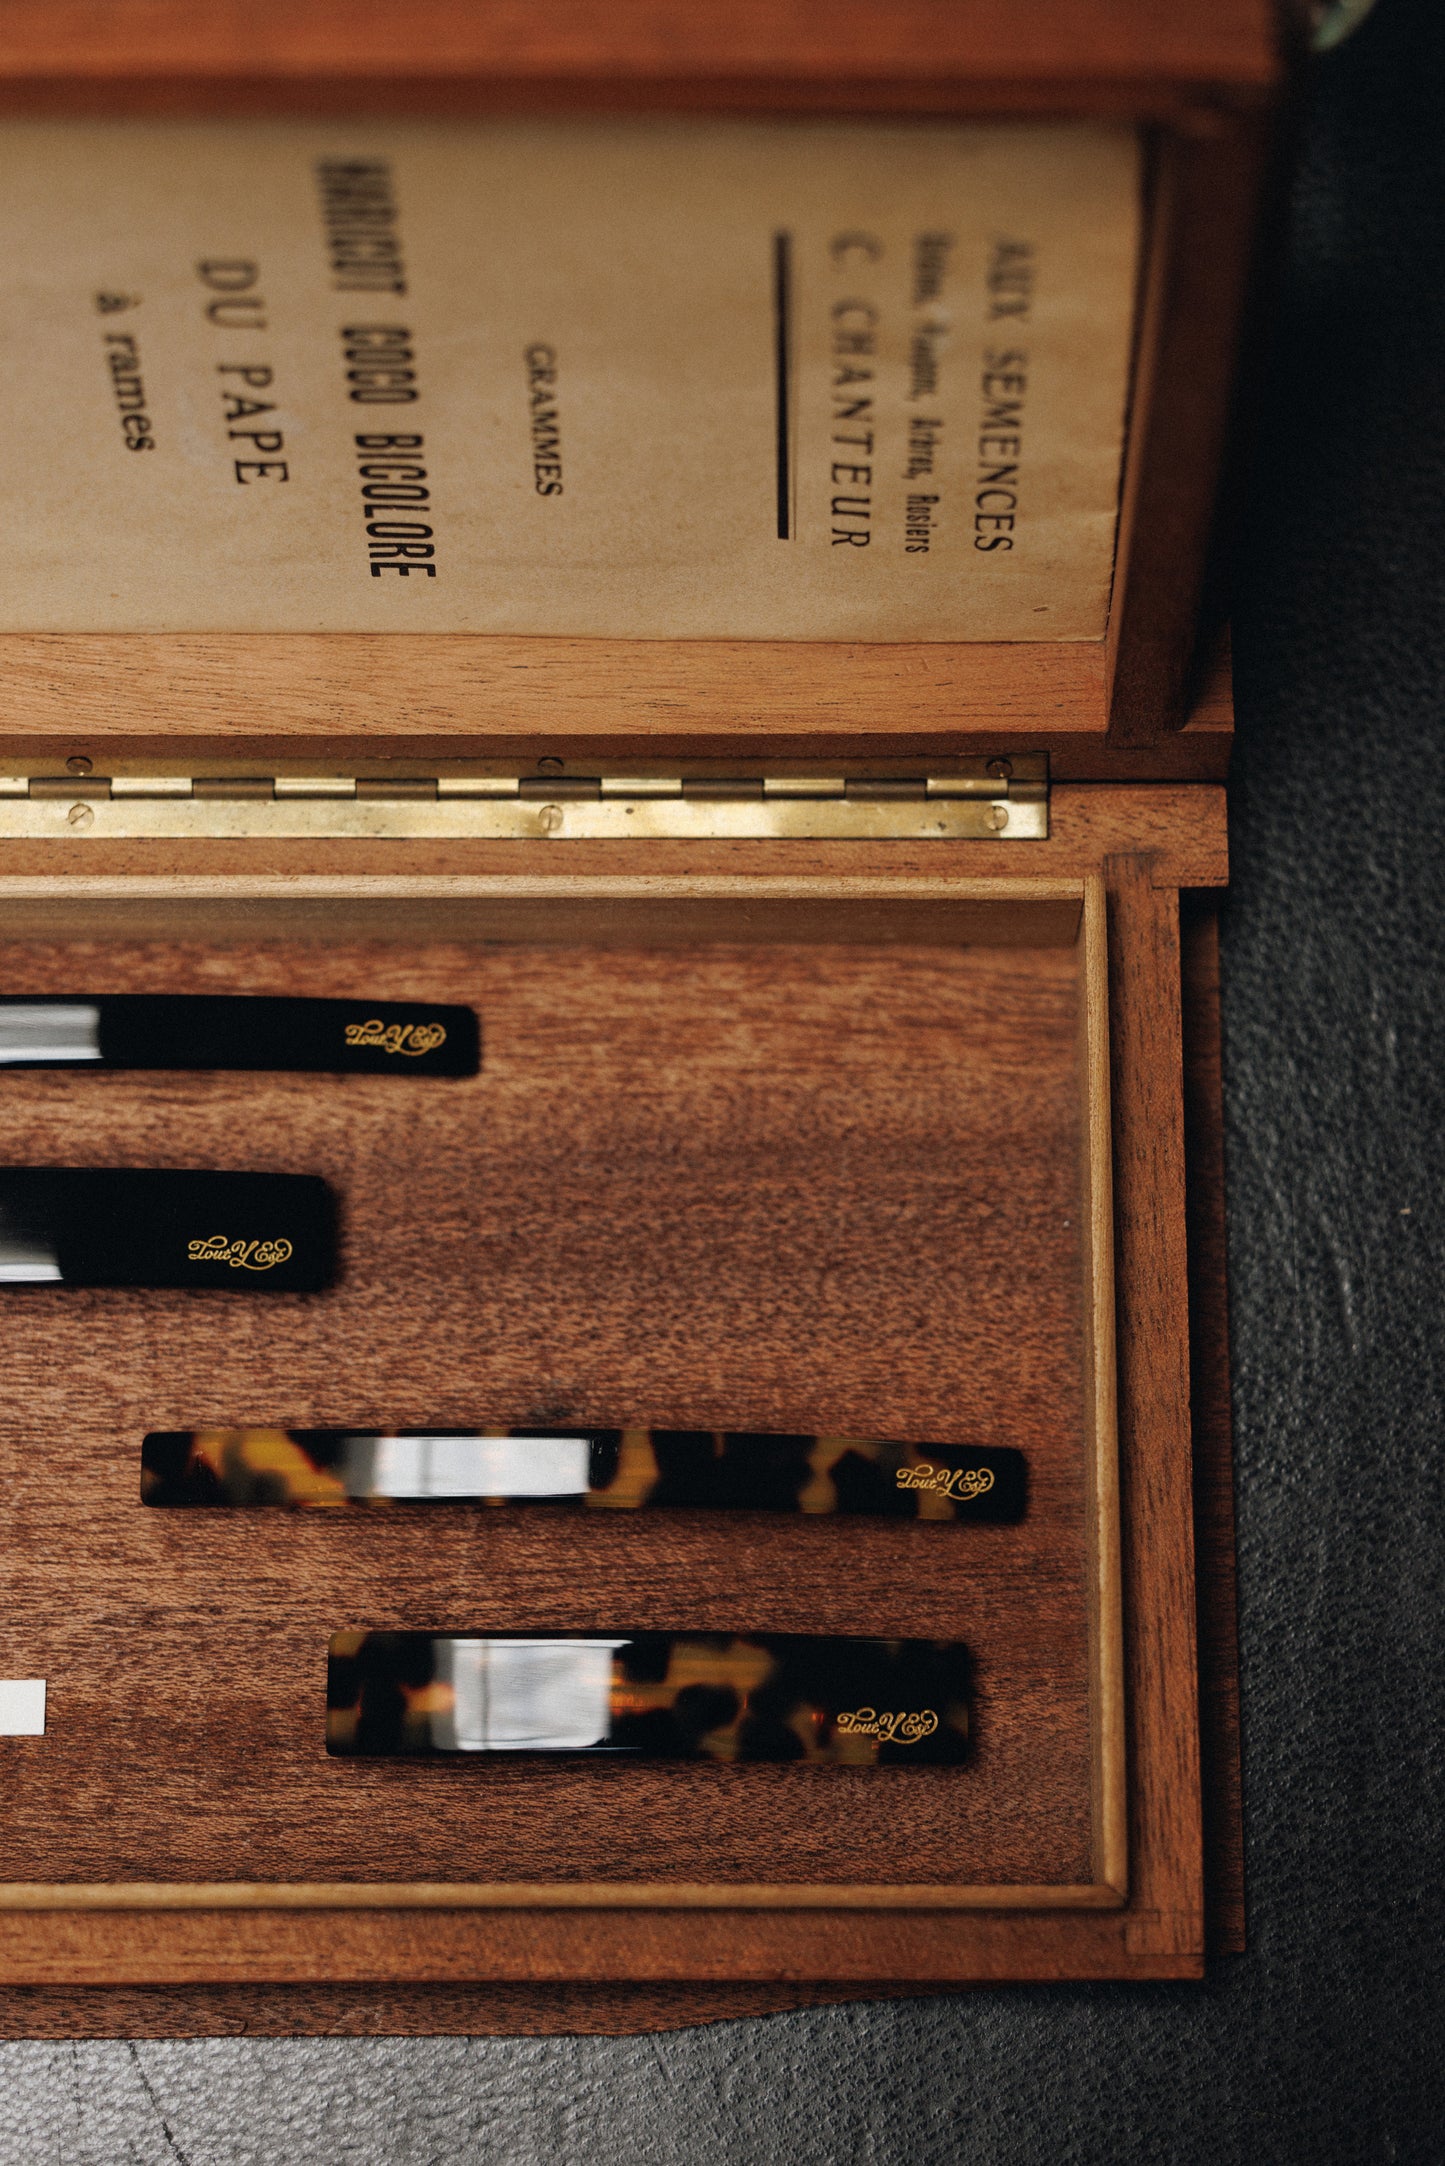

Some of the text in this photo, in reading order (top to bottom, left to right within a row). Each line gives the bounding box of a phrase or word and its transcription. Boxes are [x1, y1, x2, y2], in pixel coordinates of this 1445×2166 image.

[103, 331, 156, 453] rames
[196, 257, 290, 486] DU PAPE
[340, 324, 422, 405] COCO
[523, 342, 564, 498] GRAMMES
[830, 298, 879, 549] CHANTEUR
[974, 346, 1029, 553] SEMENCES
[354, 433, 437, 578] BICOLORE
[905, 493, 941, 555] Rosiers
[344, 1019, 388, 1046] Tout
[187, 1235, 233, 1260] Tout
[254, 1238, 293, 1263] Est
[895, 1464, 938, 1489] Tout
[958, 1467, 995, 1493] Est
[836, 1706, 880, 1734] Tout
